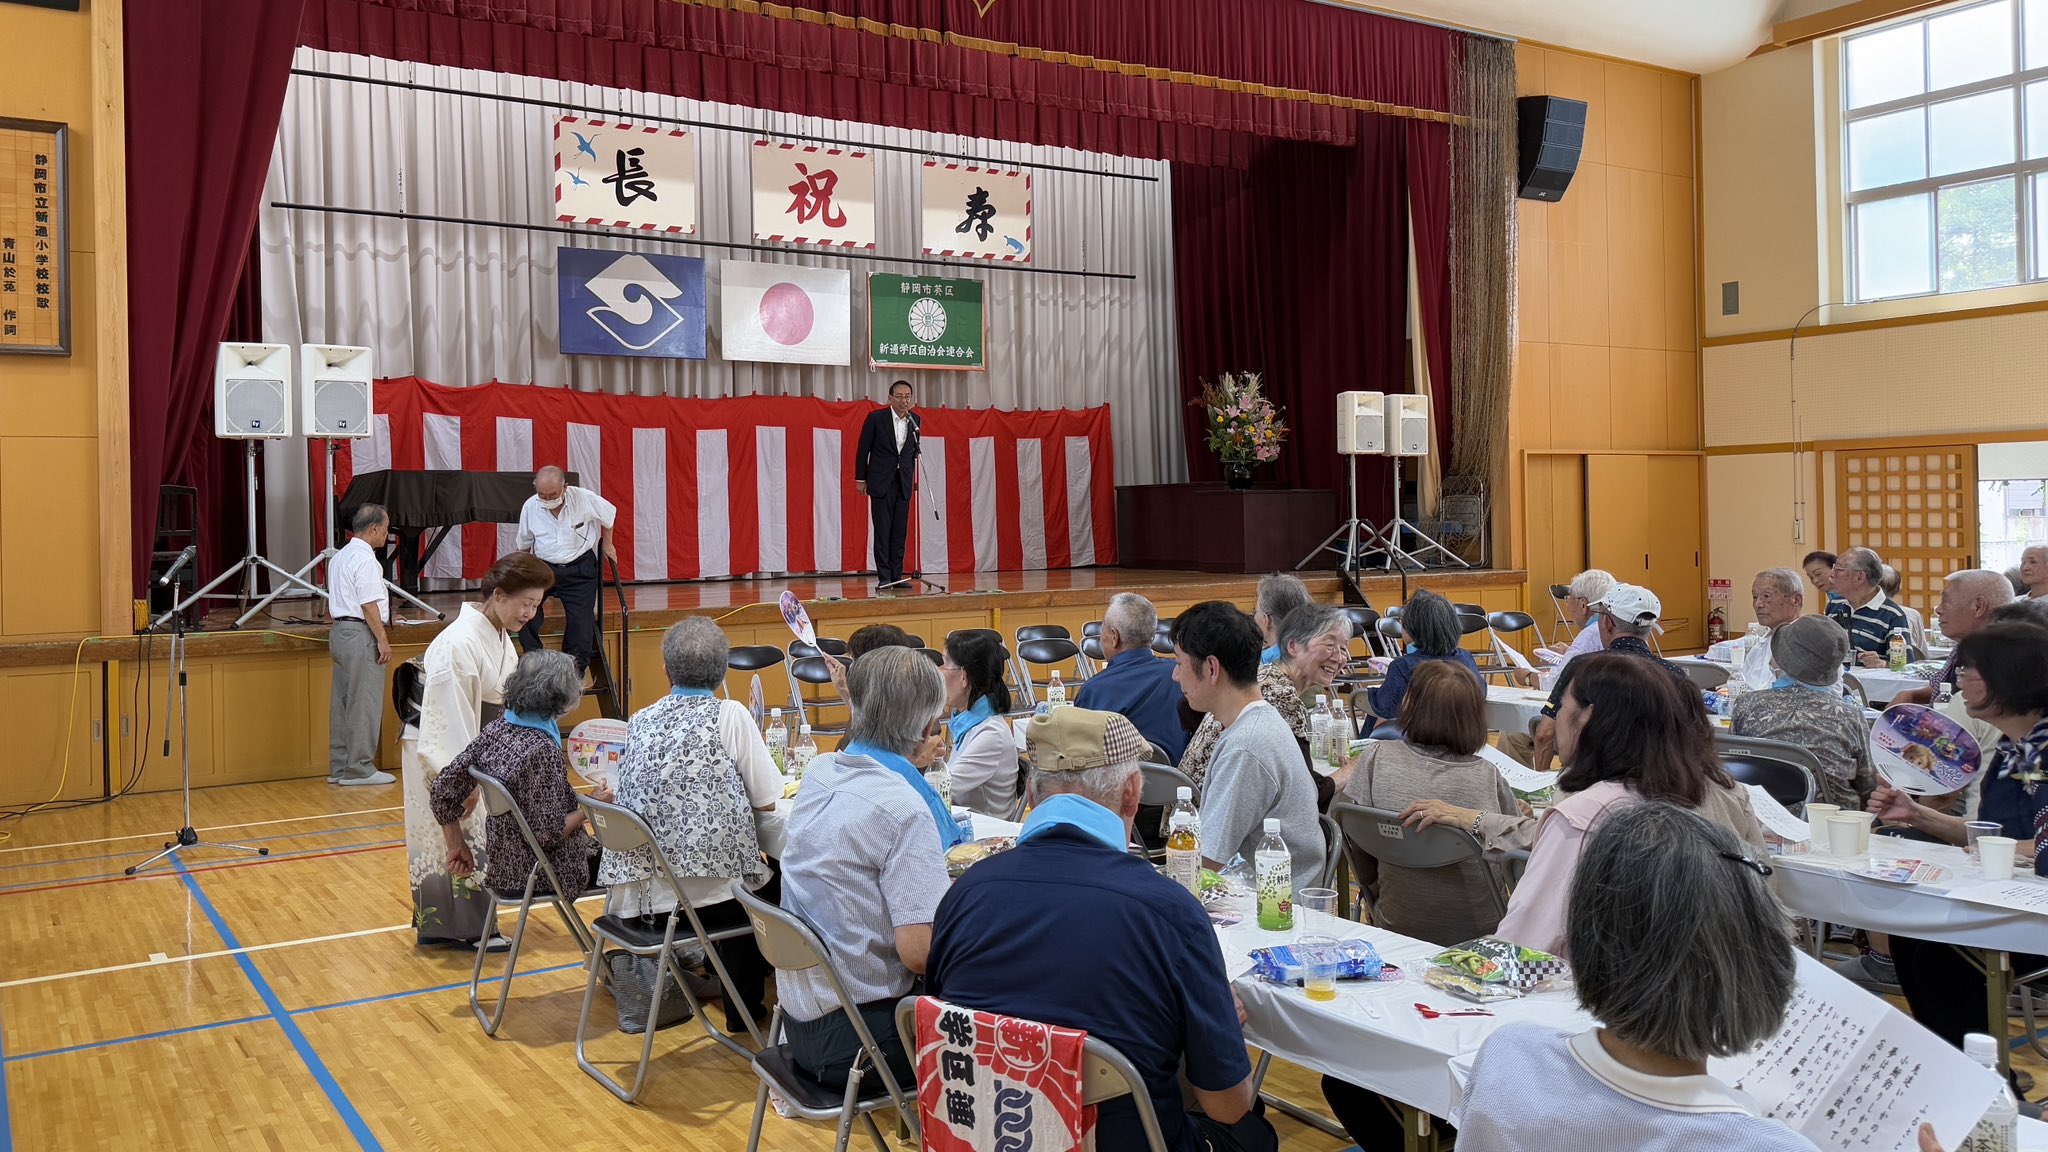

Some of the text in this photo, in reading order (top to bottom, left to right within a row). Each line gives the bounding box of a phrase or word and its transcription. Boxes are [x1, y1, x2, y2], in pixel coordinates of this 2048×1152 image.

[602, 147, 657, 207] 長
[785, 162, 847, 229] 祝
[34, 153, 50, 309] 静岡市立新通小学校校歌
[955, 186, 997, 242] 寿
[900, 282, 954, 296] 静岡市葵区
[3, 309, 17, 336] 作詞
[879, 342, 975, 358] 新通学区自治会連合会
[937, 1003, 976, 1131] 学区連
